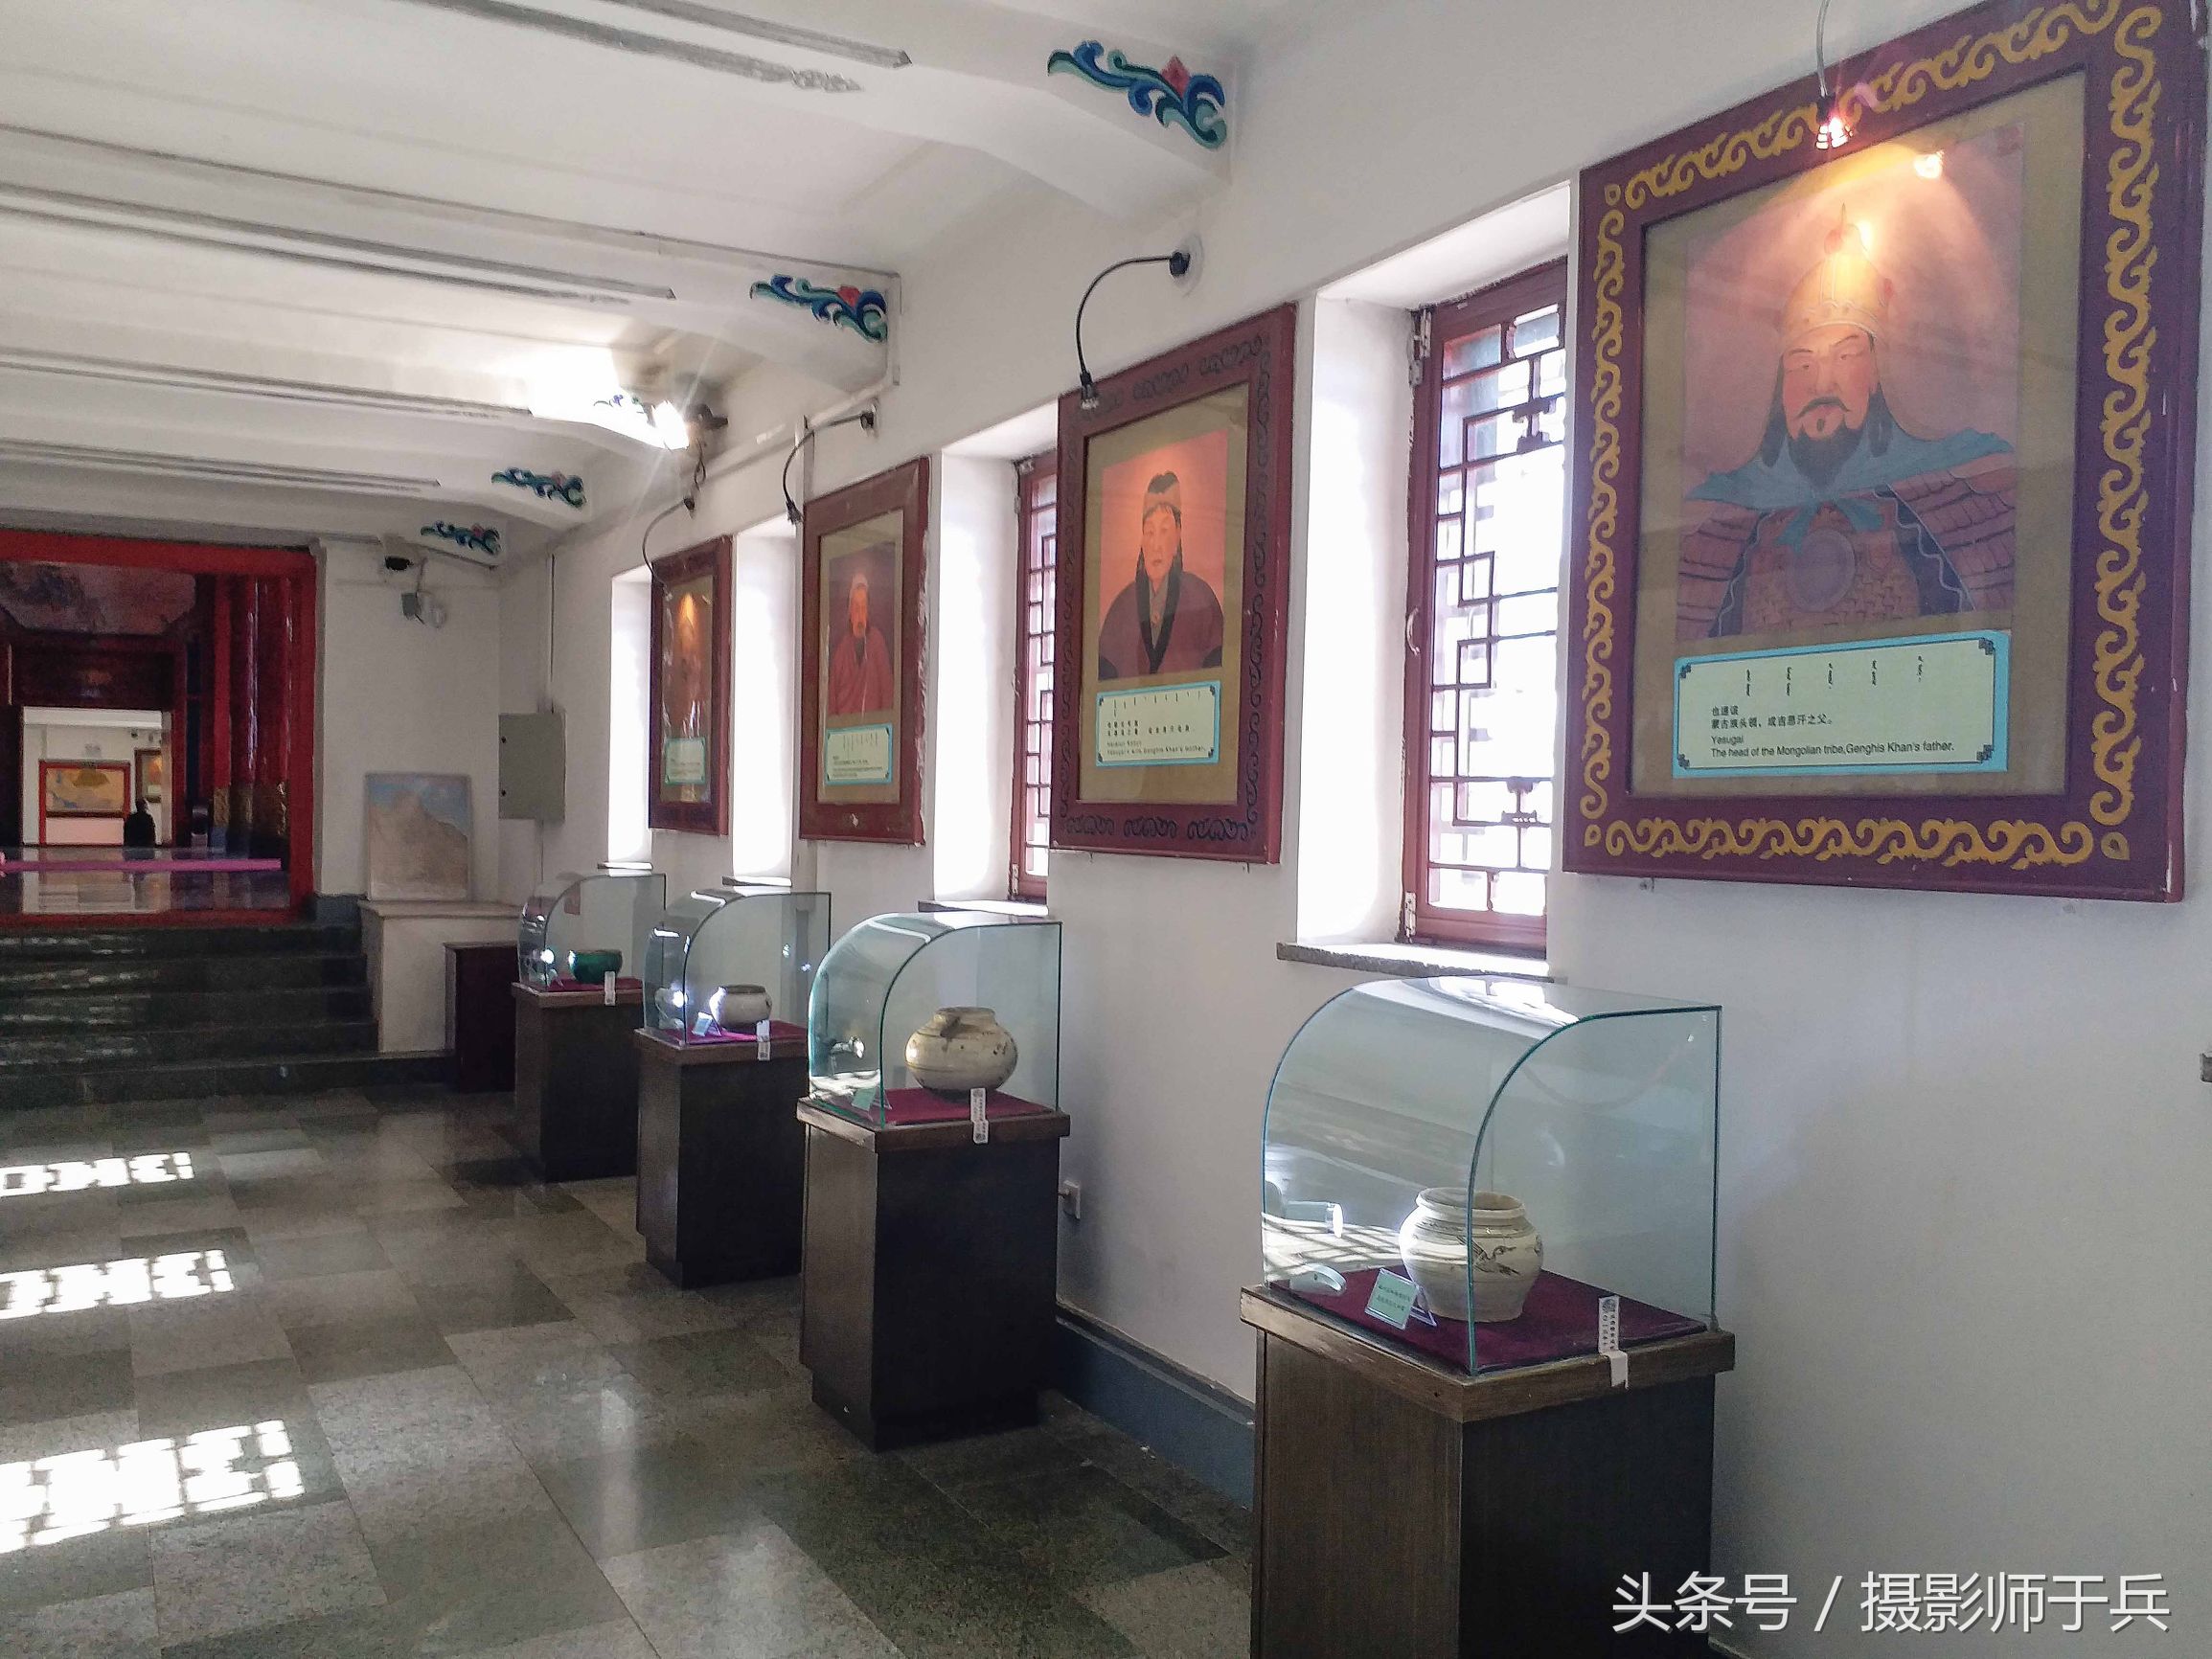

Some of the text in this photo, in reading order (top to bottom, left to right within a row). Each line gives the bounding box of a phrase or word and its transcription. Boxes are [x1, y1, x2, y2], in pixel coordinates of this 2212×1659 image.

[1711, 747, 1727, 758] The
[1728, 746, 1749, 758] head
[1750, 746, 1760, 757] of
[1761, 746, 1775, 757] the
[1776, 744, 1822, 758] Mongolian
[1887, 741, 1921, 753] Khan's
